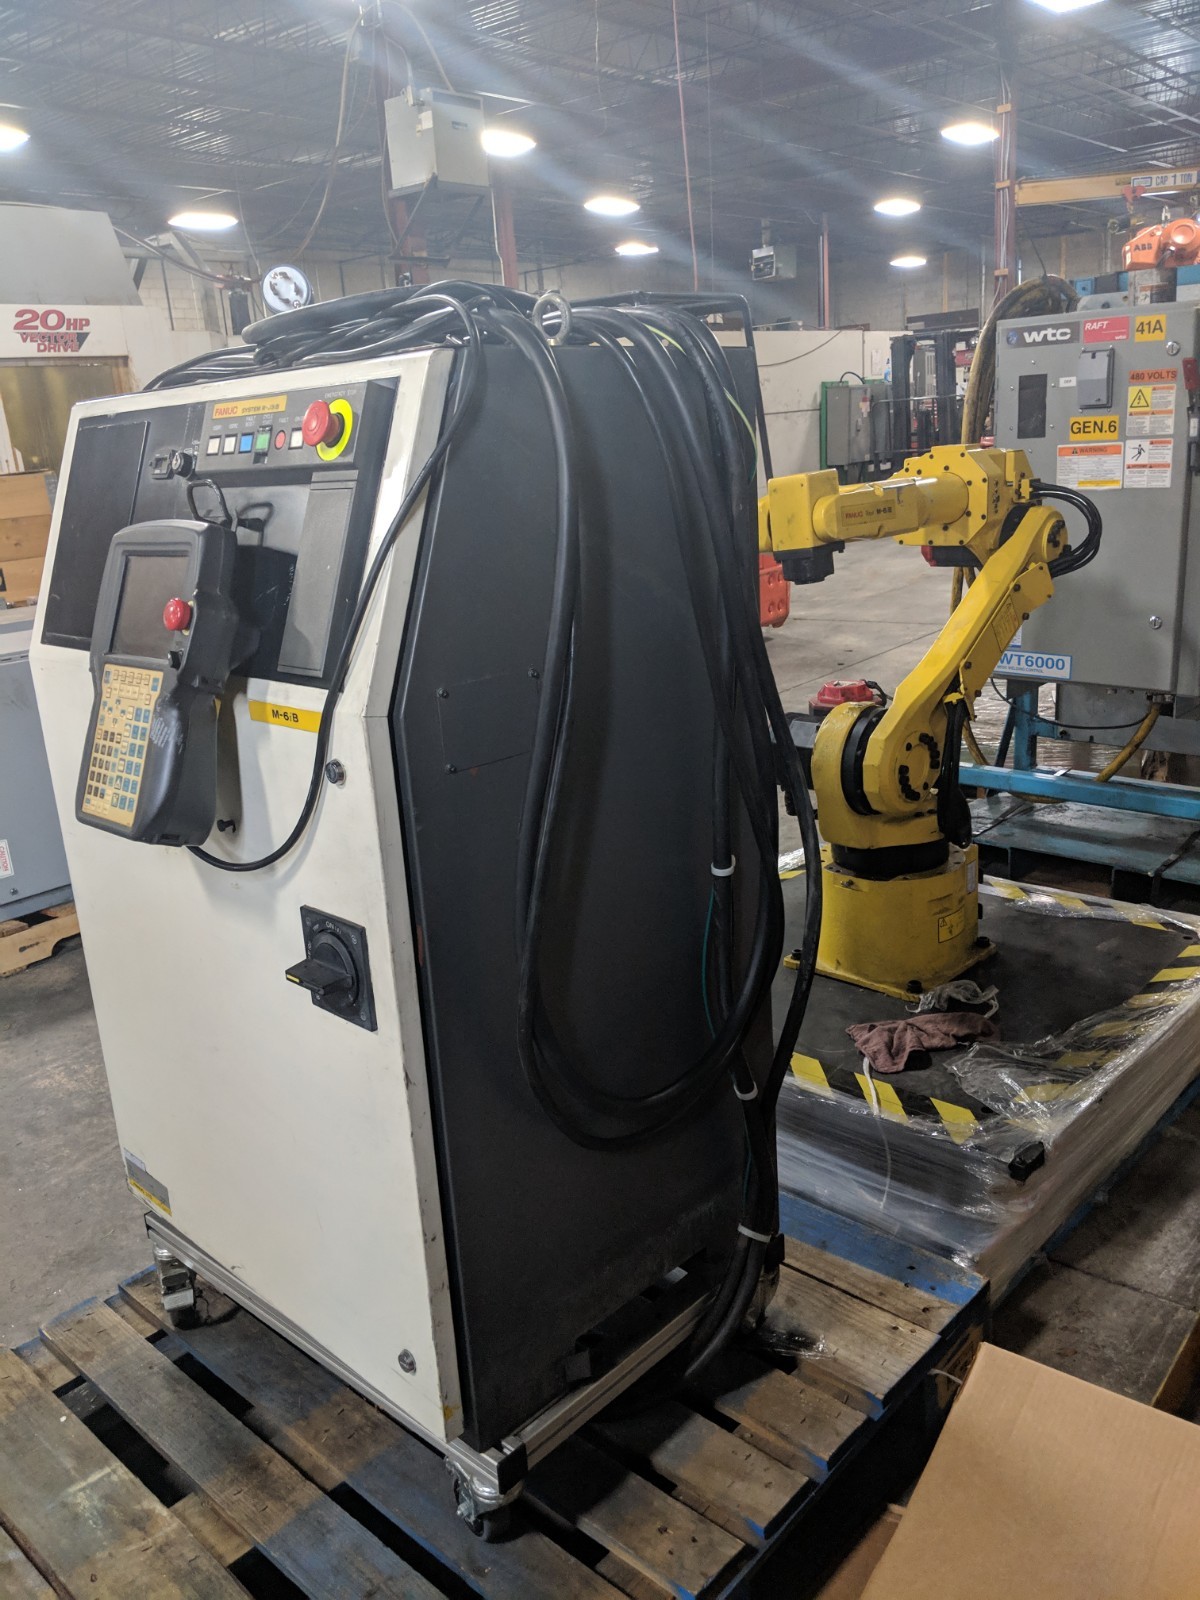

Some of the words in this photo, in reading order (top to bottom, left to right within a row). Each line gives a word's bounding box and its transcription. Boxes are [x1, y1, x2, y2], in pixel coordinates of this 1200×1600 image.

[1156, 175, 1168, 186] CAP
[1085, 321, 1109, 331] RAFT
[1135, 319, 1164, 334] 41A
[20, 332, 78, 343] VECTOR
[1023, 327, 1072, 343] wtc
[37, 342, 79, 353] DRIVE
[1130, 372, 1145, 381] 480
[1147, 370, 1177, 380] VOLTS
[214, 406, 239, 417] FANUC
[241, 405, 261, 414] SYSTEM
[1070, 420, 1117, 434] GEN.6
